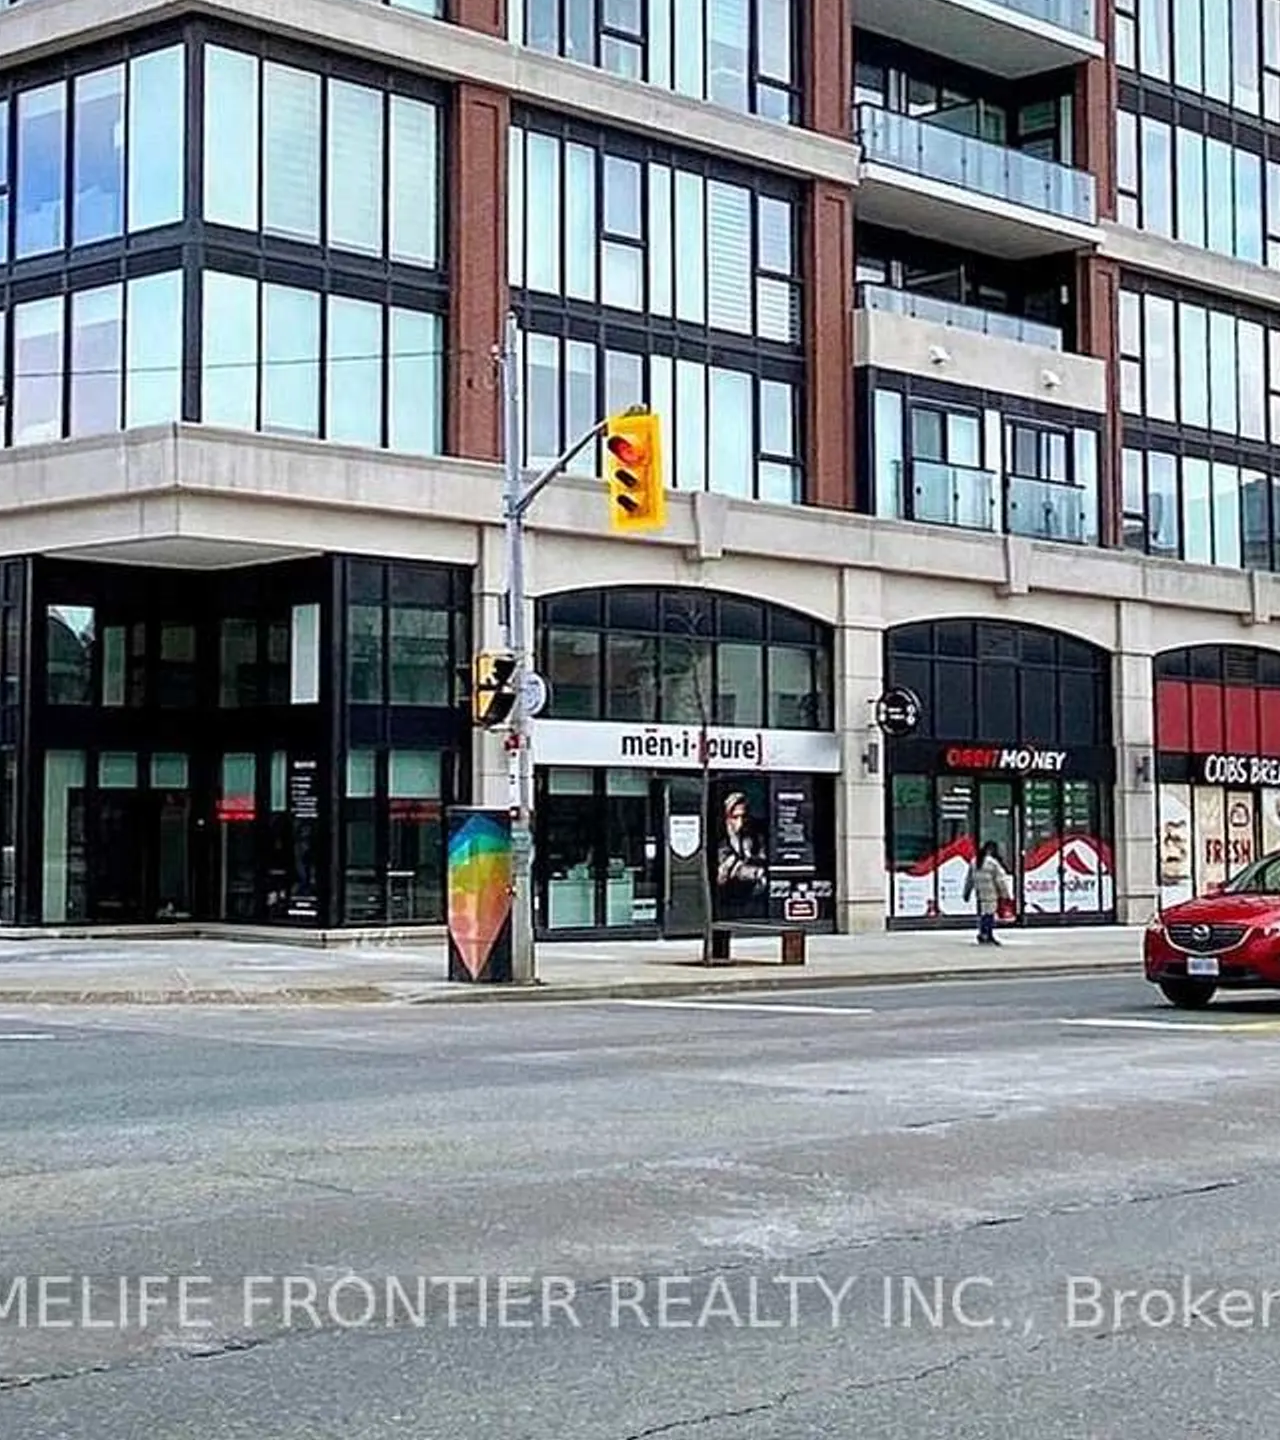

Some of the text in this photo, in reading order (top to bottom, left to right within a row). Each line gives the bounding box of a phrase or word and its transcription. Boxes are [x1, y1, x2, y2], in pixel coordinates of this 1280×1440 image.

[999, 749, 1066, 771] MONEY
[1205, 754, 1248, 783] COBS
[1206, 839, 1251, 864] FRESH
